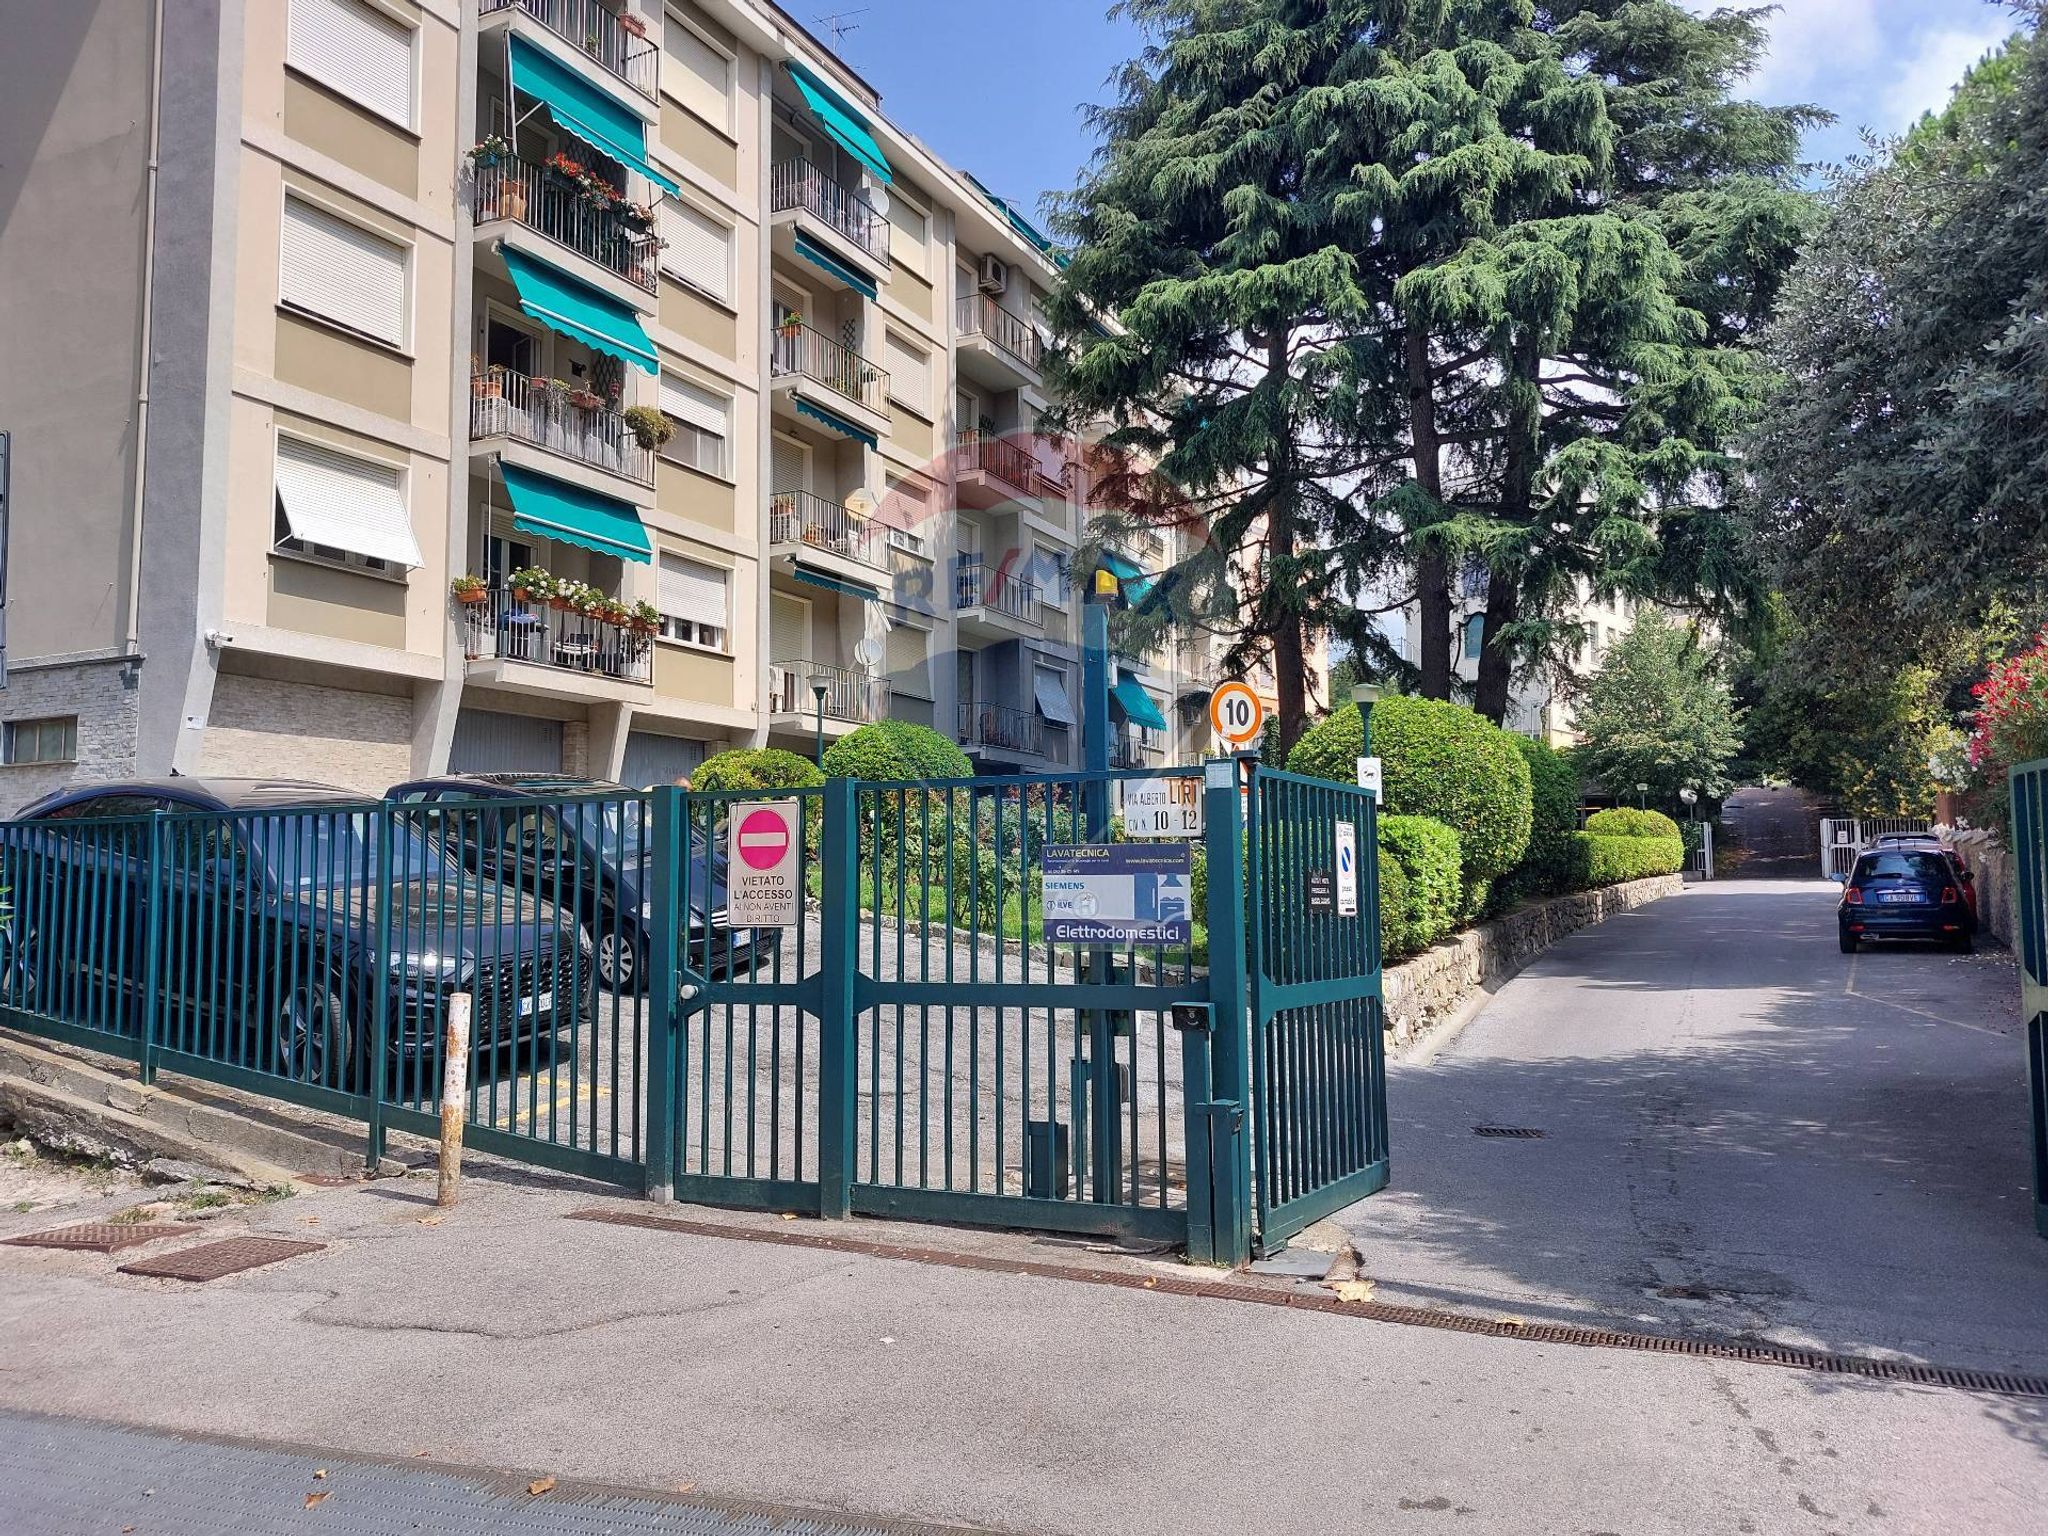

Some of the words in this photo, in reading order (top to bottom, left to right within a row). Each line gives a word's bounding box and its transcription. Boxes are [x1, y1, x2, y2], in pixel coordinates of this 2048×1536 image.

[1226, 698, 1249, 726] 10
[1127, 792, 1138, 805] VIA
[1140, 791, 1166, 805] ALBERTO
[1170, 782, 1197, 805] LIRI
[1154, 810, 1169, 830] 10
[1182, 810, 1197, 830] 12
[1046, 849, 1110, 858] LAVATECNICA
[742, 875, 784, 886] VIETATO
[1045, 882, 1085, 890] SIEMENS
[734, 889, 793, 900] L'ACCESSO
[743, 902, 762, 911] NON
[764, 902, 794, 911] AVENTI
[1056, 924, 1179, 940] Elettrodomestici
